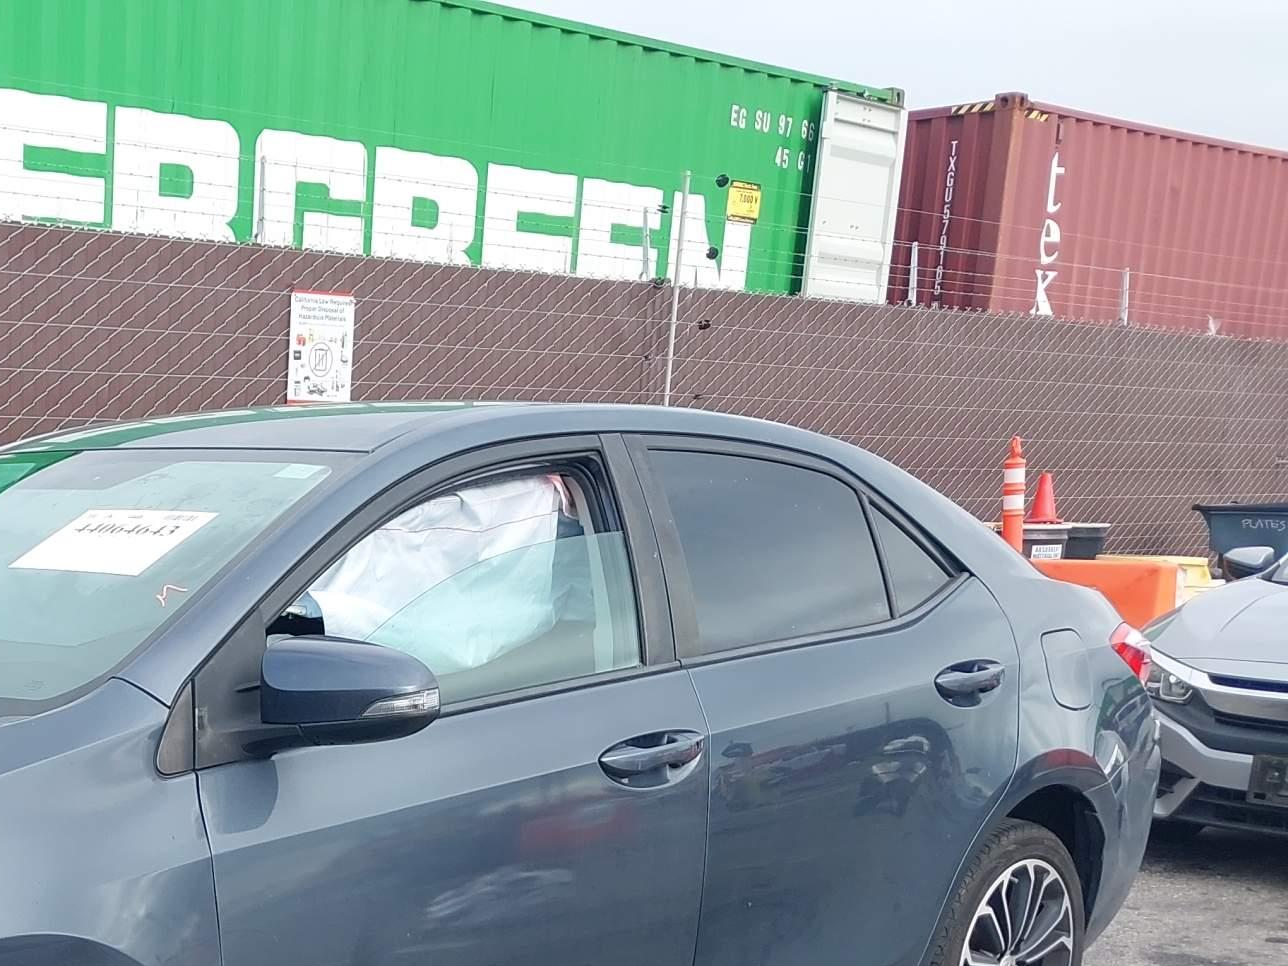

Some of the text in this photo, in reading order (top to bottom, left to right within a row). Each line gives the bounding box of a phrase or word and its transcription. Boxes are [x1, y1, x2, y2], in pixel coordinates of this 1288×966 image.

[730, 104, 747, 129] EG
[754, 110, 771, 133] SU
[778, 114, 793, 138] 97
[775, 146, 790, 169] 45
